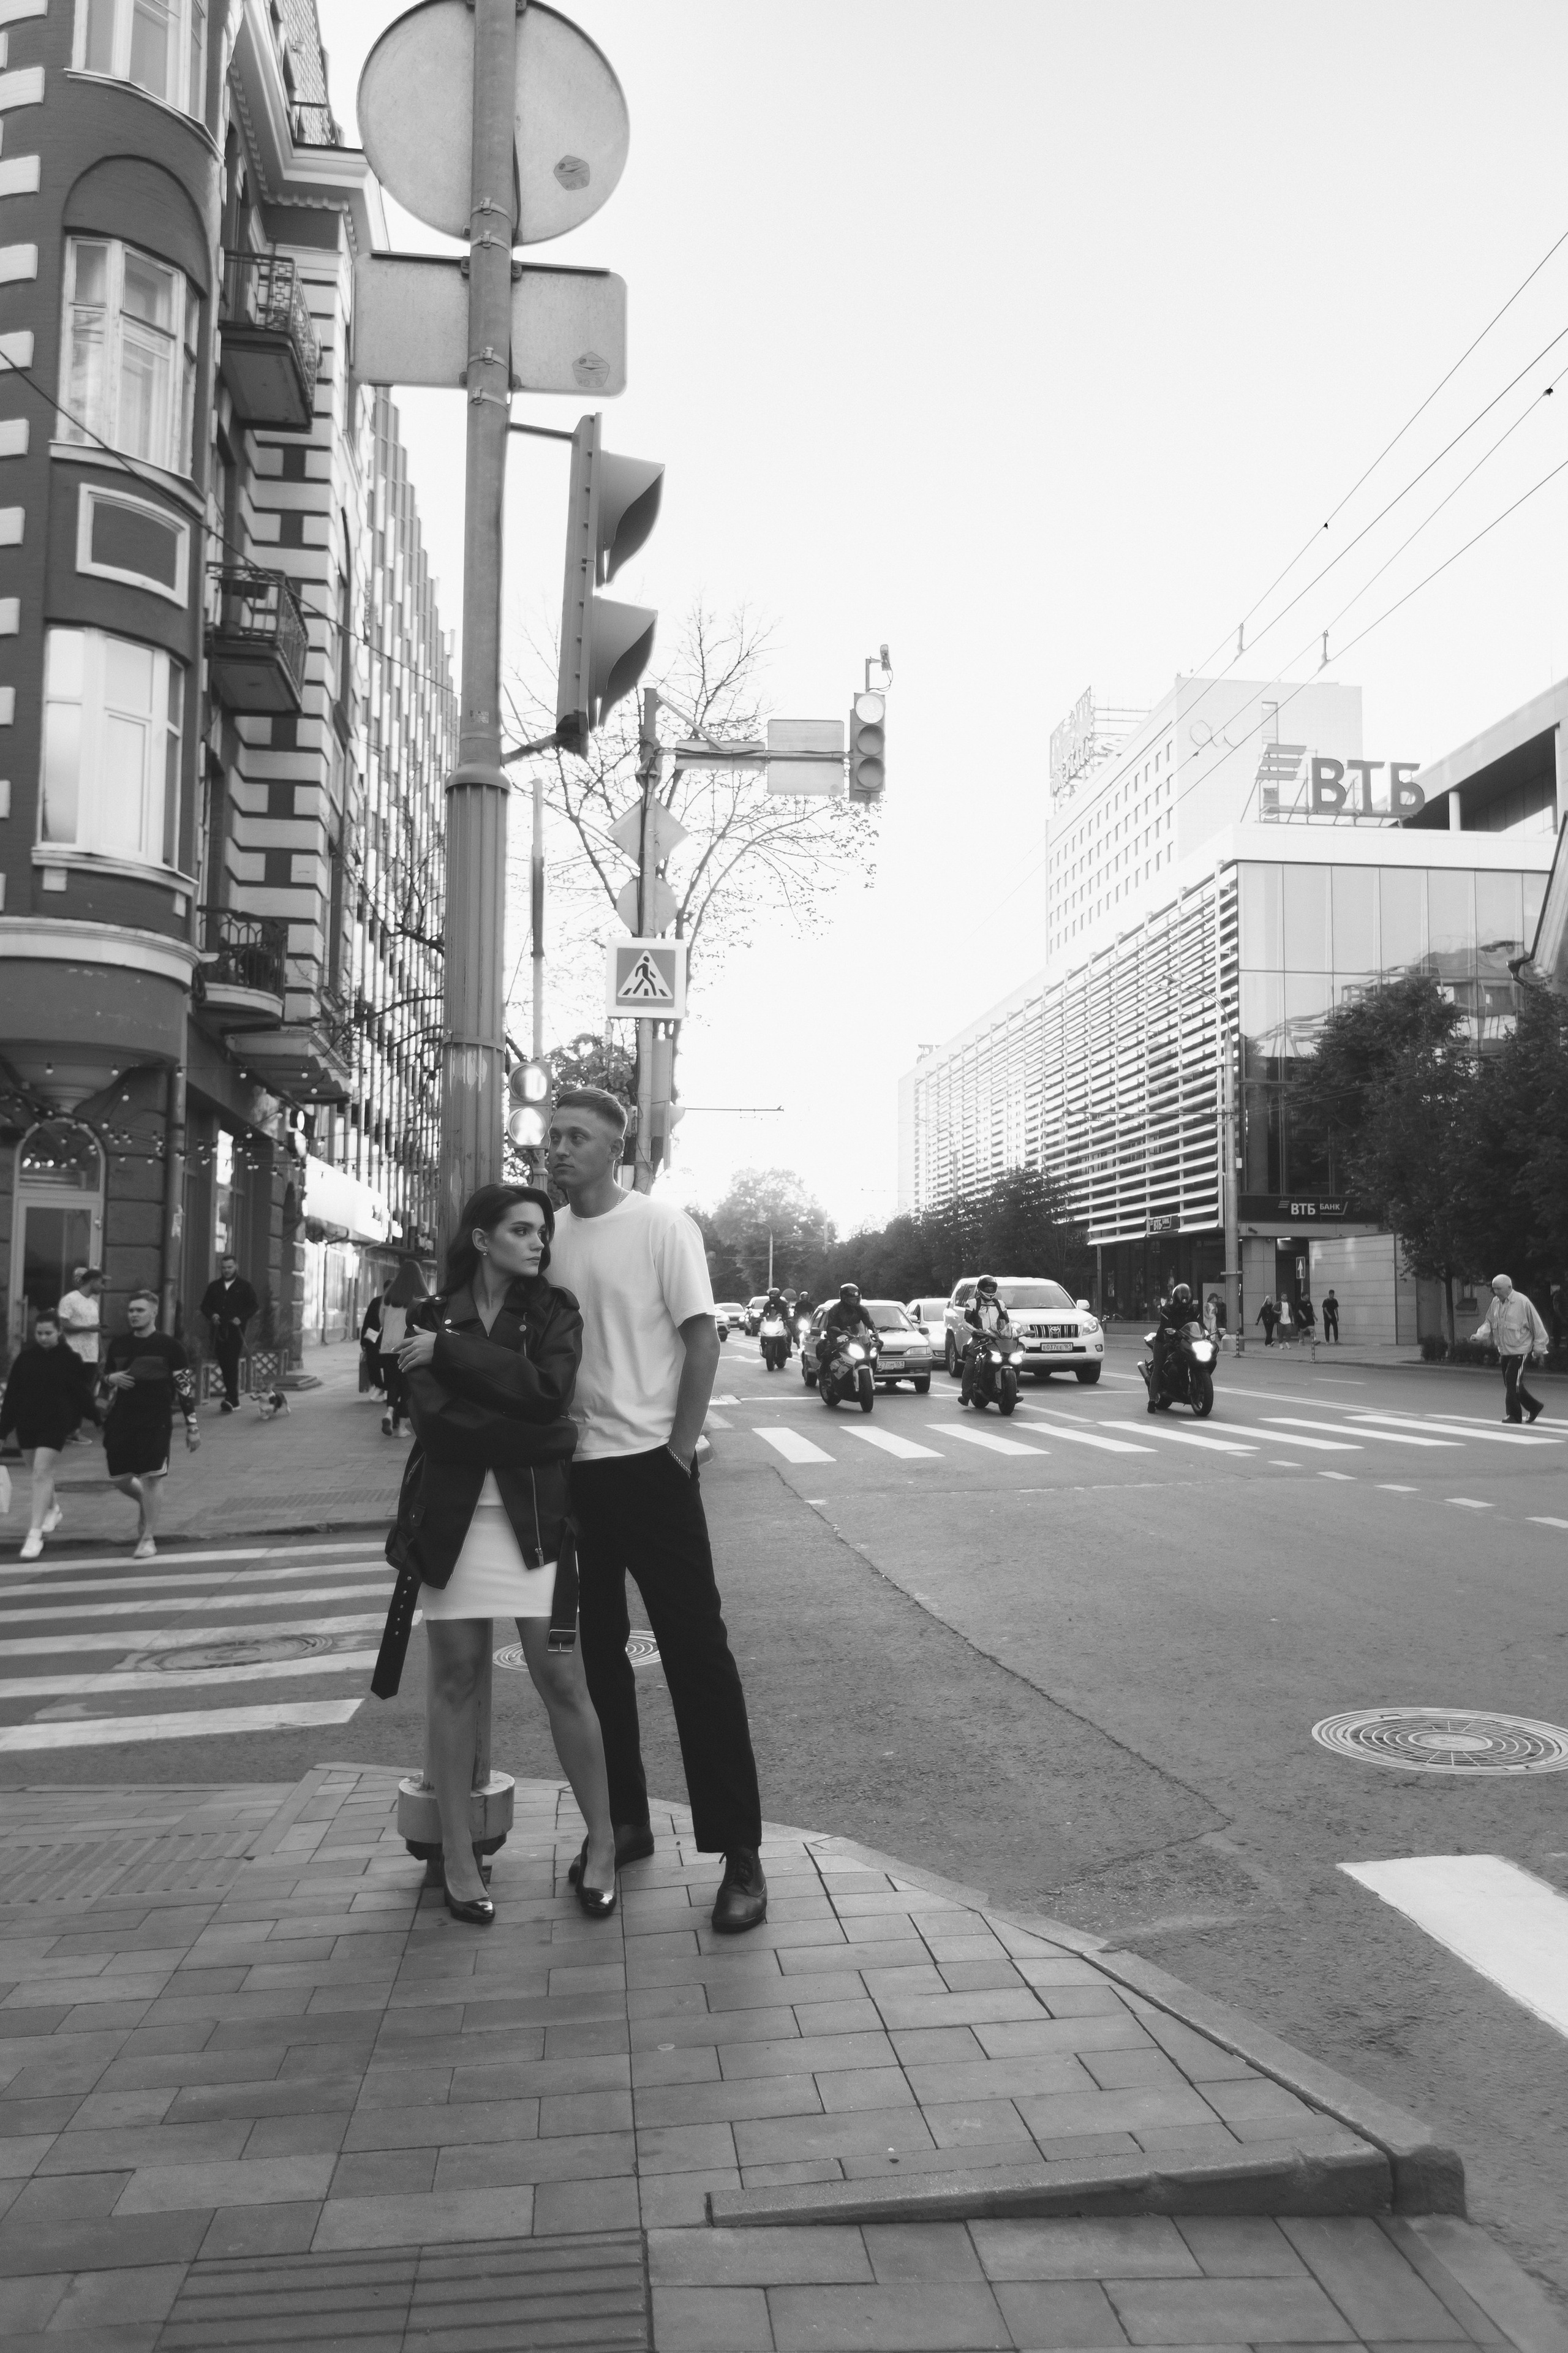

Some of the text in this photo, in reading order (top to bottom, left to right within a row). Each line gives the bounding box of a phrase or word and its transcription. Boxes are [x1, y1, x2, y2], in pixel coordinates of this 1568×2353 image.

[1311, 758, 1425, 814] ВТБ
[1291, 1203, 1316, 1215] ВТБ
[1153, 1219, 1163, 1231] ВТБ
